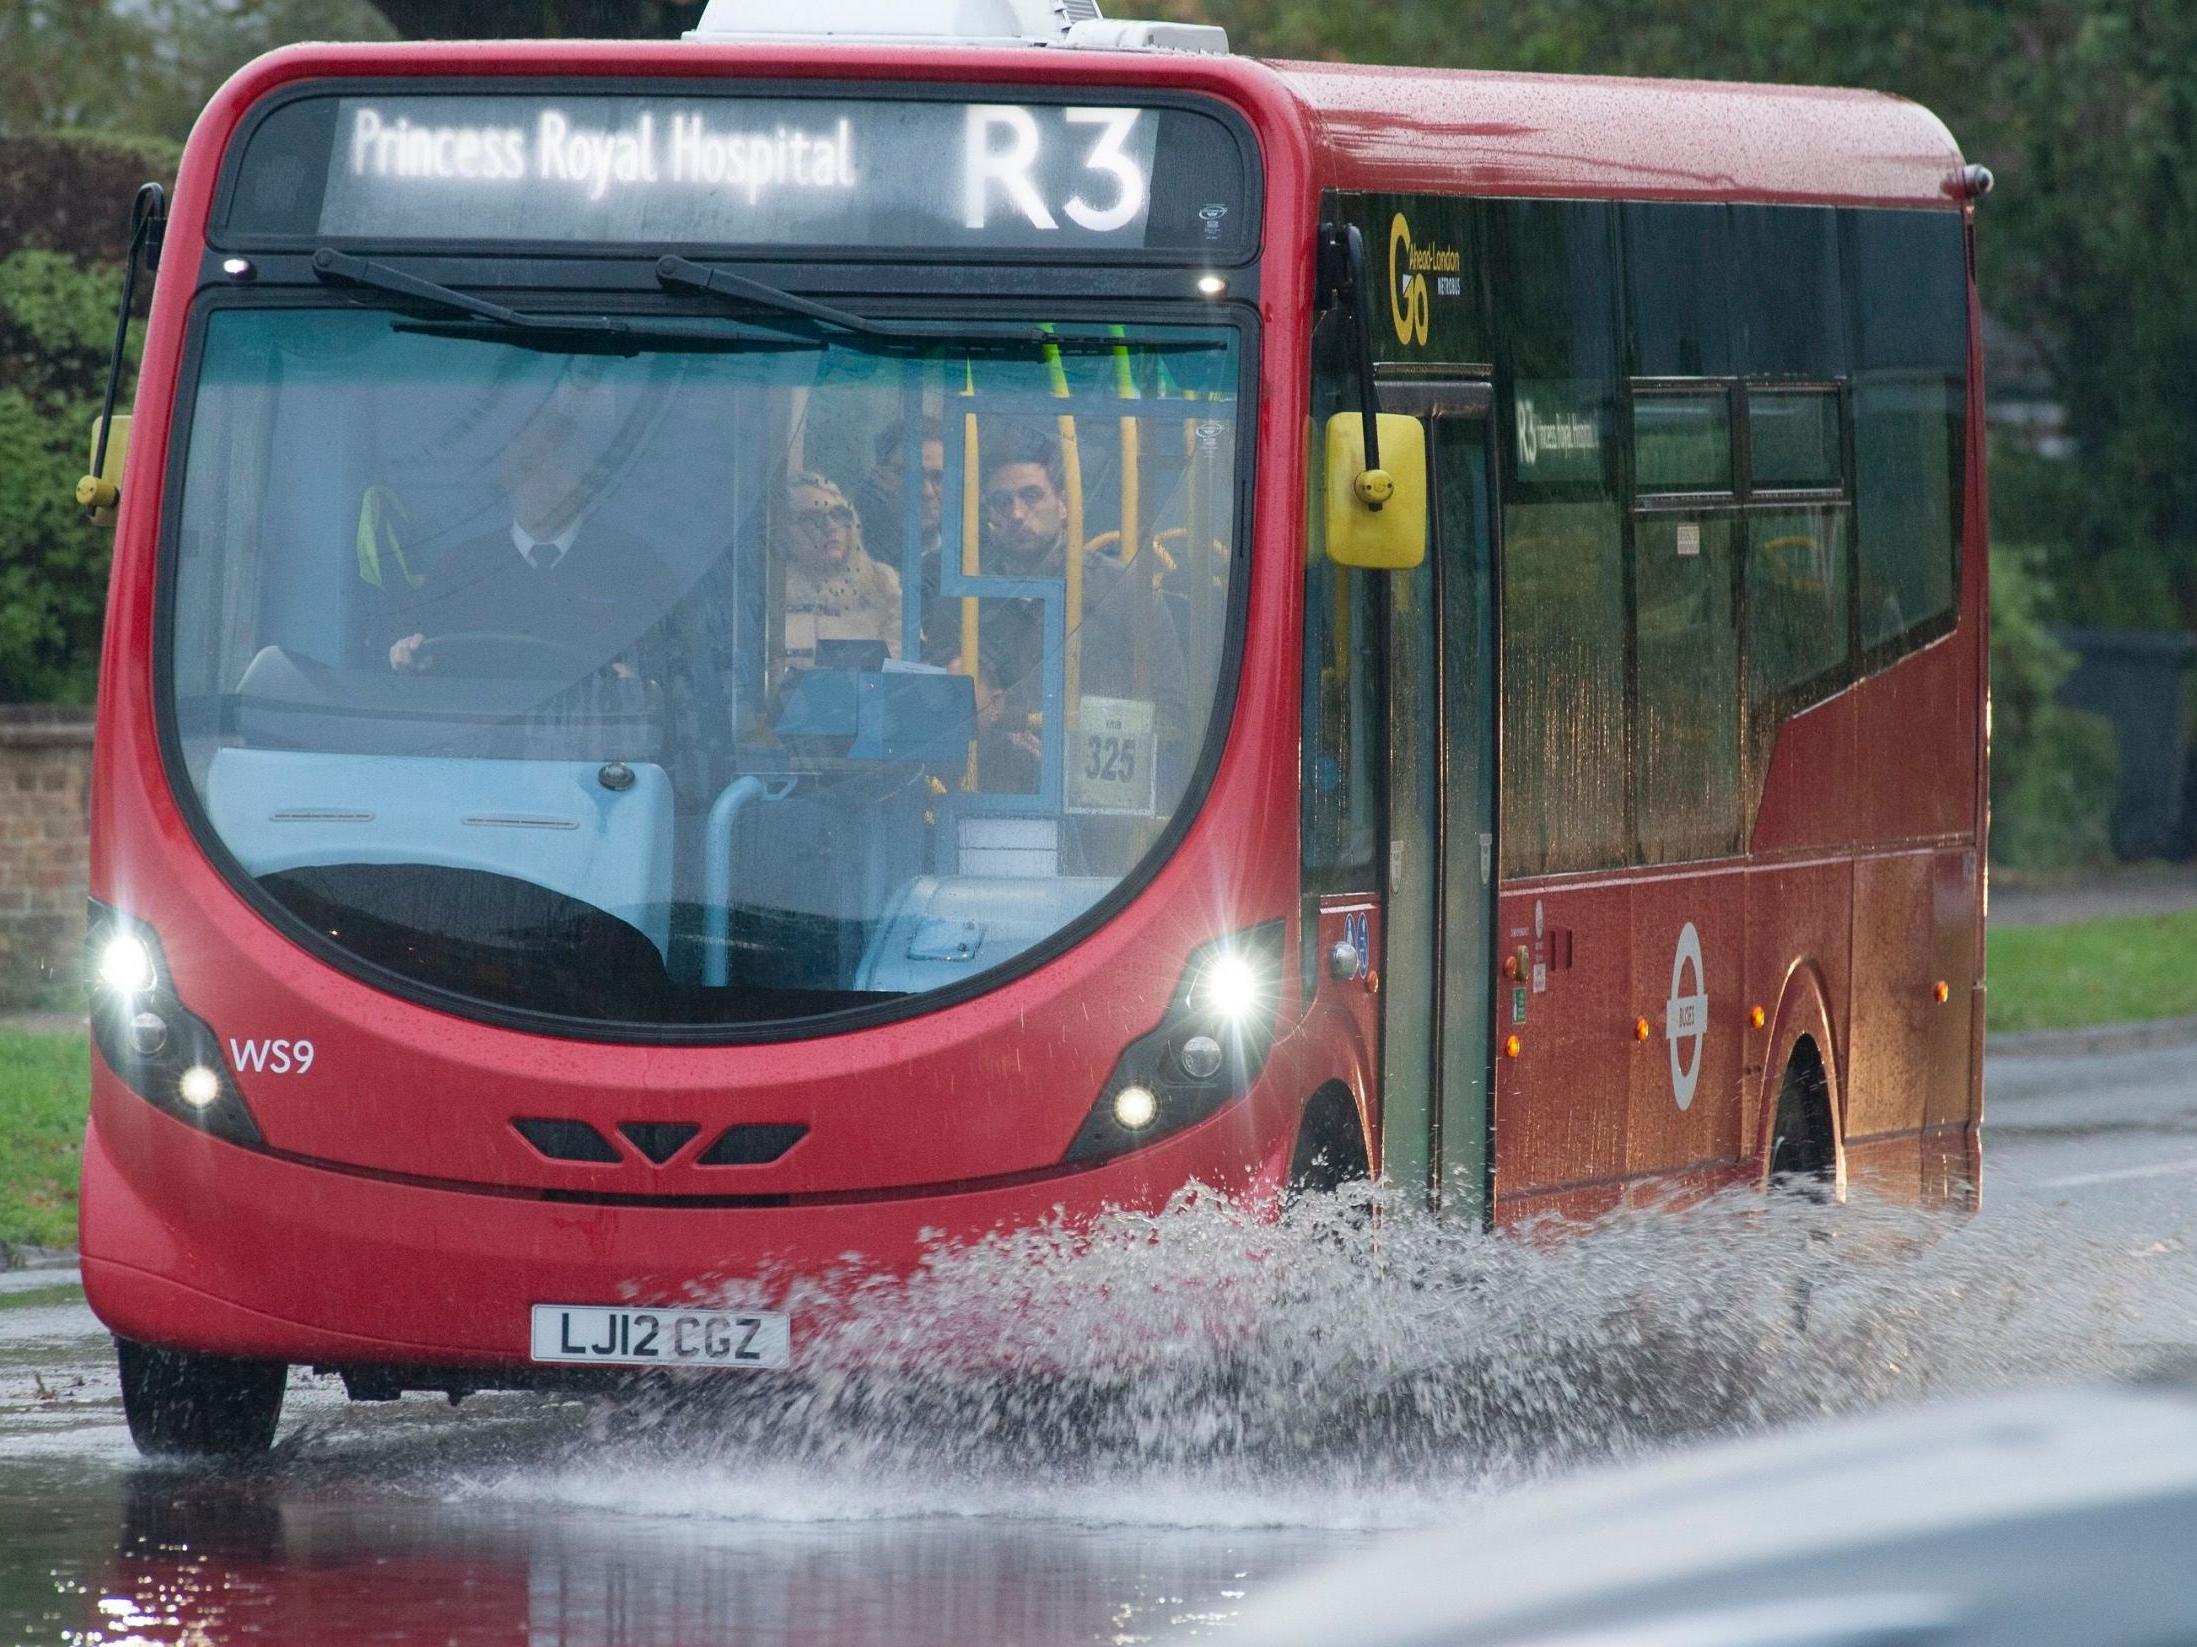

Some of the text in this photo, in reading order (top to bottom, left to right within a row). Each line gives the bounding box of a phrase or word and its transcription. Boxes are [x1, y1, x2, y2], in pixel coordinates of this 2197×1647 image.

[351, 104, 1146, 232] Princess Royal Hospital R3
[1389, 212, 1429, 346] Go
[1086, 735, 1136, 783] 325
[229, 1038, 315, 1074] WS9
[561, 1312, 761, 1360] LJ12 CGZ
